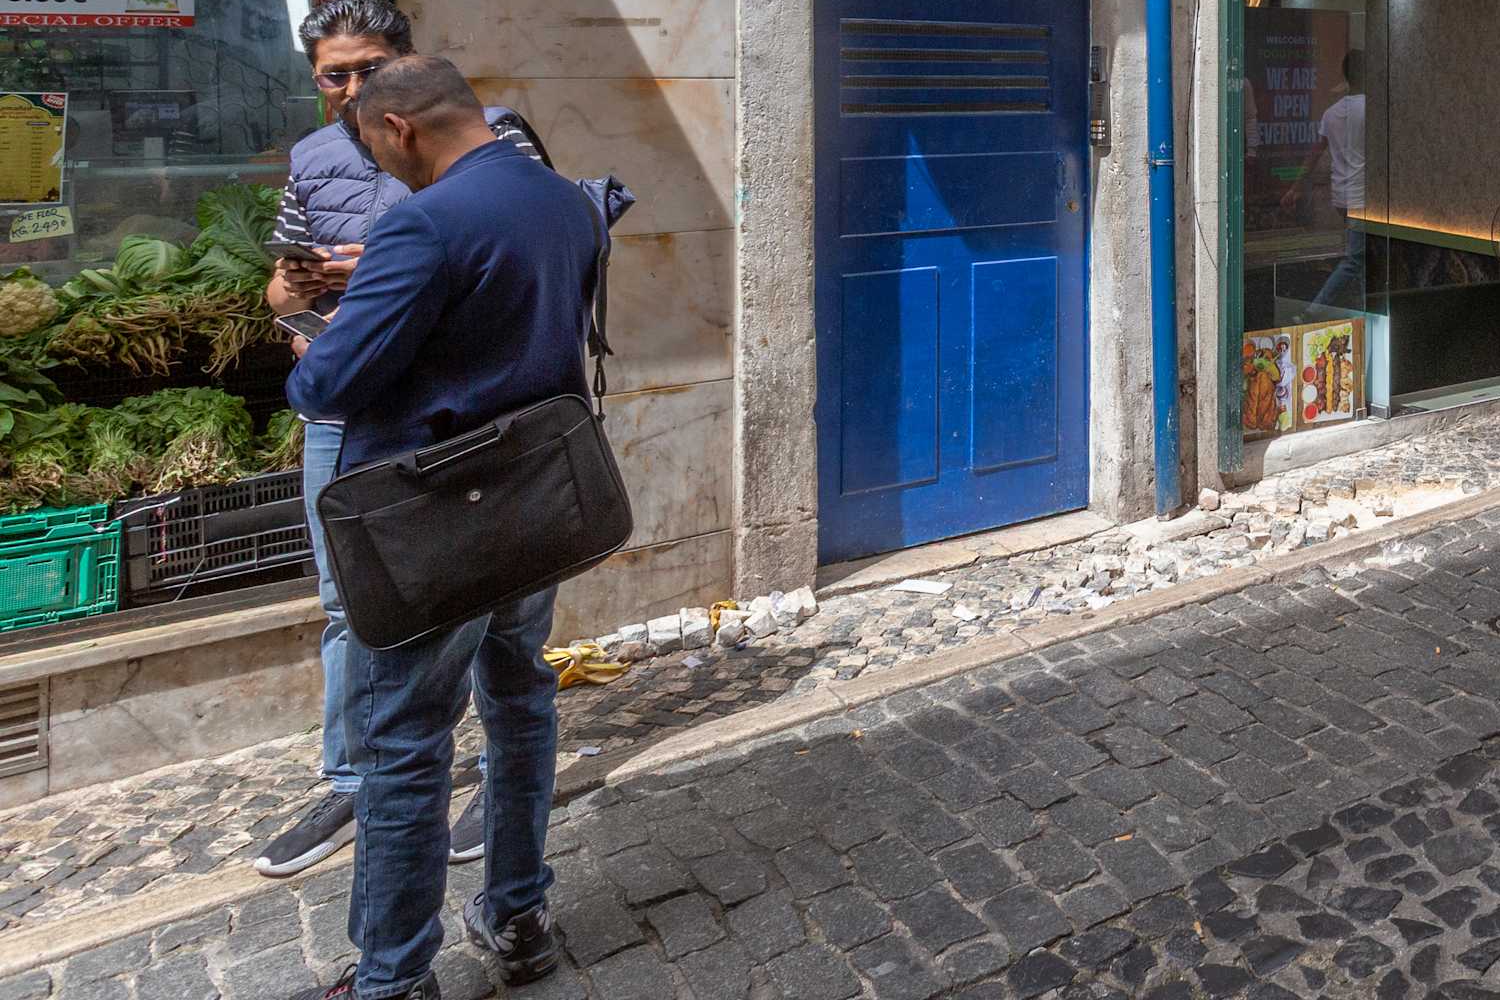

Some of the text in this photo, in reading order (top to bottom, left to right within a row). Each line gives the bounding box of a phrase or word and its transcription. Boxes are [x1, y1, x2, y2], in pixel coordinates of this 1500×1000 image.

[0, 15, 183, 27] ECIAL OFFER
[1266, 67, 1317, 90] WE ARE
[1274, 94, 1309, 118] OPEN
